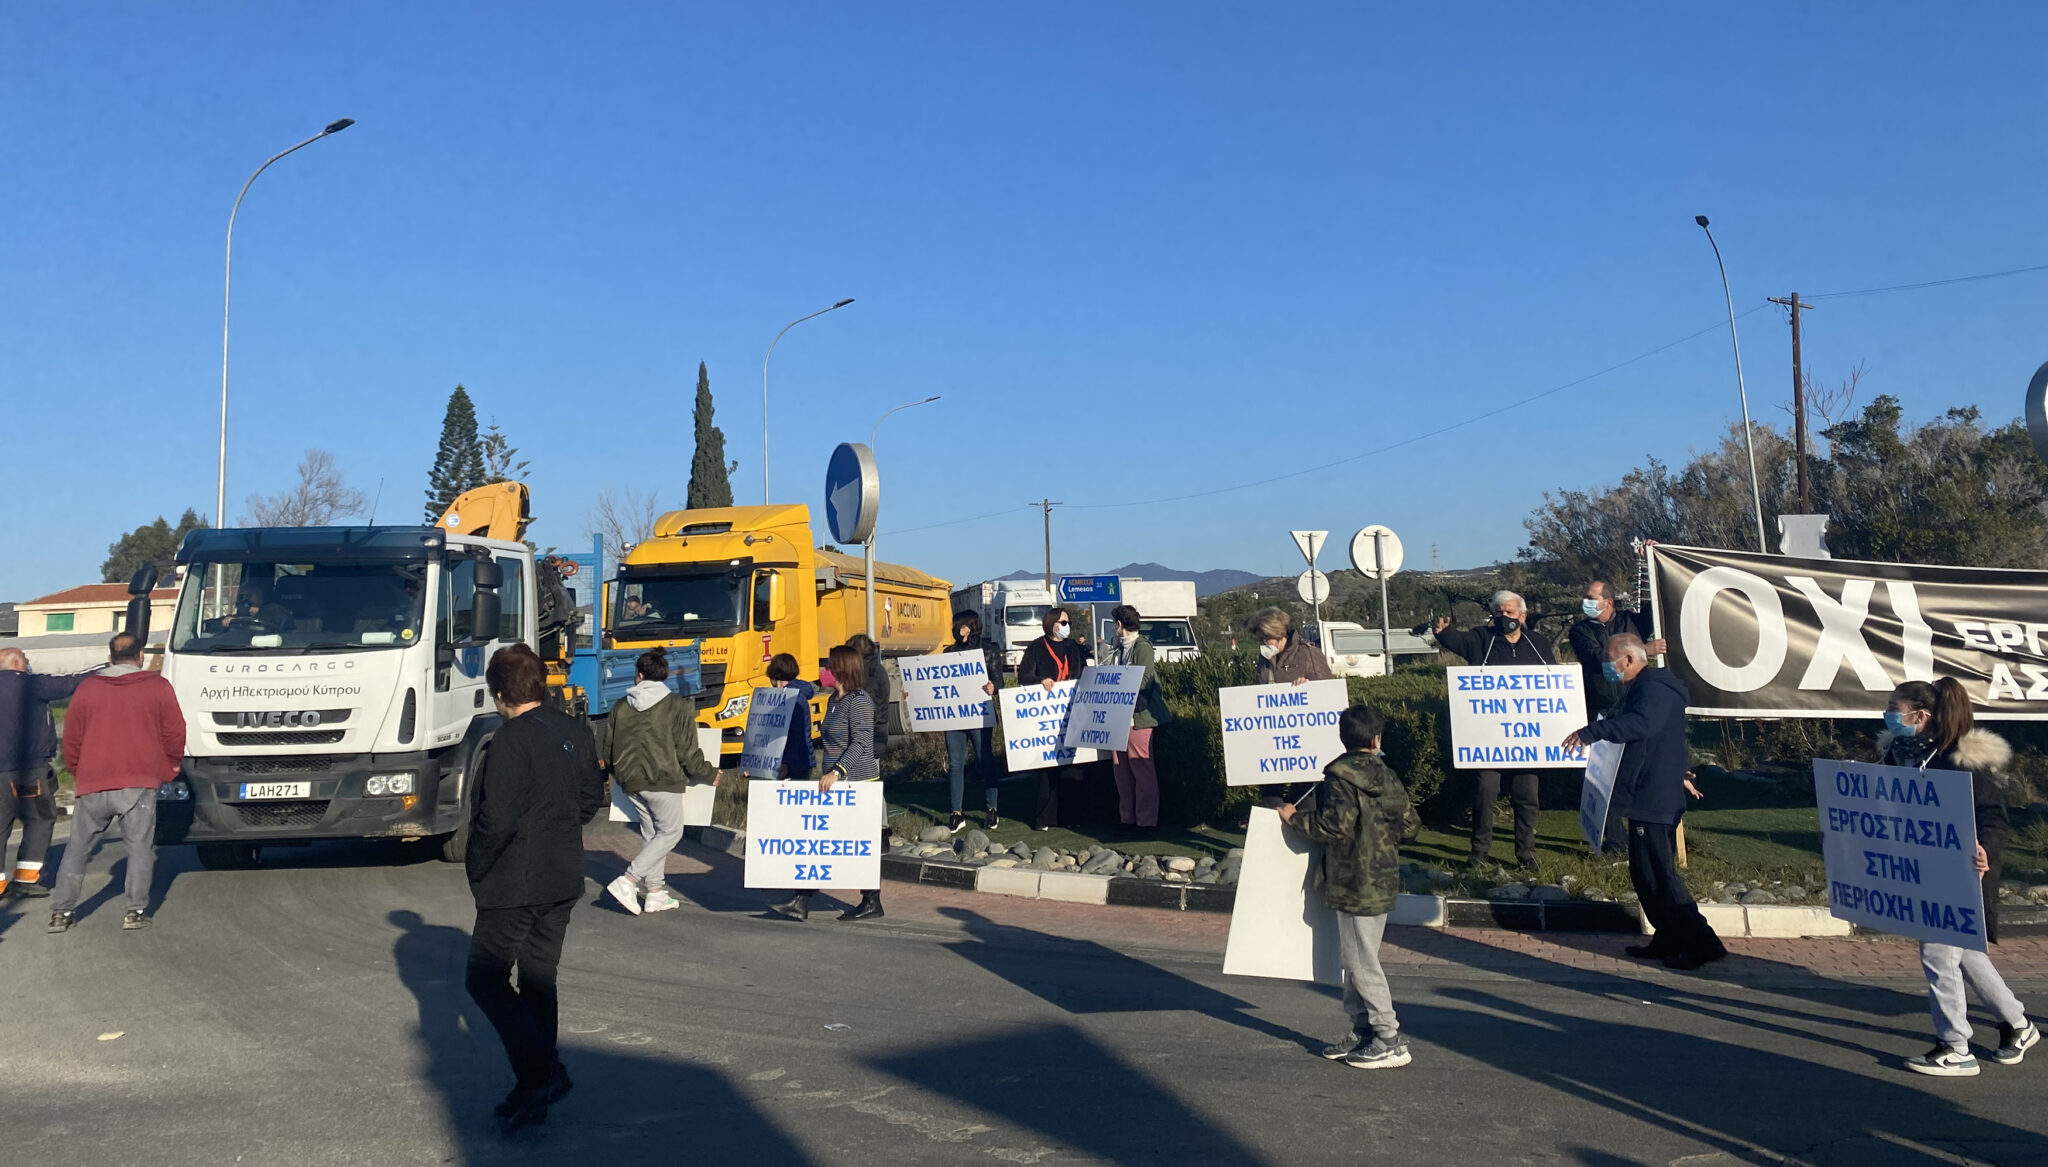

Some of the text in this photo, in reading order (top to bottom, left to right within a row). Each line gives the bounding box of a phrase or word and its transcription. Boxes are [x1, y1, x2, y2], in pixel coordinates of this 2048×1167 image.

[1680, 566, 1934, 692] ΟΧΙ
[700, 646, 714, 656] ort)
[209, 661, 354, 673] EUROCARGO
[903, 661, 985, 681] Η ΔΥΣΟΣΜΙΑ
[1095, 672, 1122, 685] ΓΙΝΑΜΕ
[1457, 674, 1575, 691] ΣΕΒΑΣΤΕΙΤΕ
[200, 684, 361, 700] Αρχή Ηλεκτρισμού Κύπρου
[932, 684, 960, 699] ΣΤΑ
[1015, 691, 1041, 704] ΟΧΙ
[1257, 692, 1308, 709] ΓΙΝΑΜΕ
[1469, 698, 1568, 714] ΤΗΝ ΥΓΕΙΑ
[237, 710, 321, 728] IVECO
[914, 702, 989, 721] ΣΠΙΤΙΑ ΜΑΣ
[1016, 703, 1072, 719] ΜΟΛΥΝ
[1092, 711, 1107, 723] ΤΗΣ
[1081, 729, 1110, 744] ΚΥΠΡΟΥ
[1501, 722, 1541, 738] ΤΩΝ
[1273, 735, 1301, 750] ΤΗΣ
[1043, 748, 1076, 761] ΜΑΣ
[1458, 746, 1538, 762] ΠΑΙΔΙΩΝ
[1260, 756, 1317, 773] ΚΥΠΡΟΥ
[250, 784, 299, 797] LAH271
[1836, 771, 1941, 807] ΟΧΙ ΑΛΛΑ
[776, 789, 857, 806] ΤΗΡΗΣΤΕ
[801, 814, 829, 831] ΤΙΣ
[1828, 807, 1962, 851] ΕΡΓΟΣΤΑΣΙΑ
[758, 838, 872, 856] ΥΠΟΣΧΕΣΕΙΣ
[794, 864, 832, 881] ΣΑΣ
[1863, 850, 1921, 885] ΣΤΗΝ
[1831, 881, 1978, 936] ΠΕΡΙΟΧΗ ΜΑΣ
